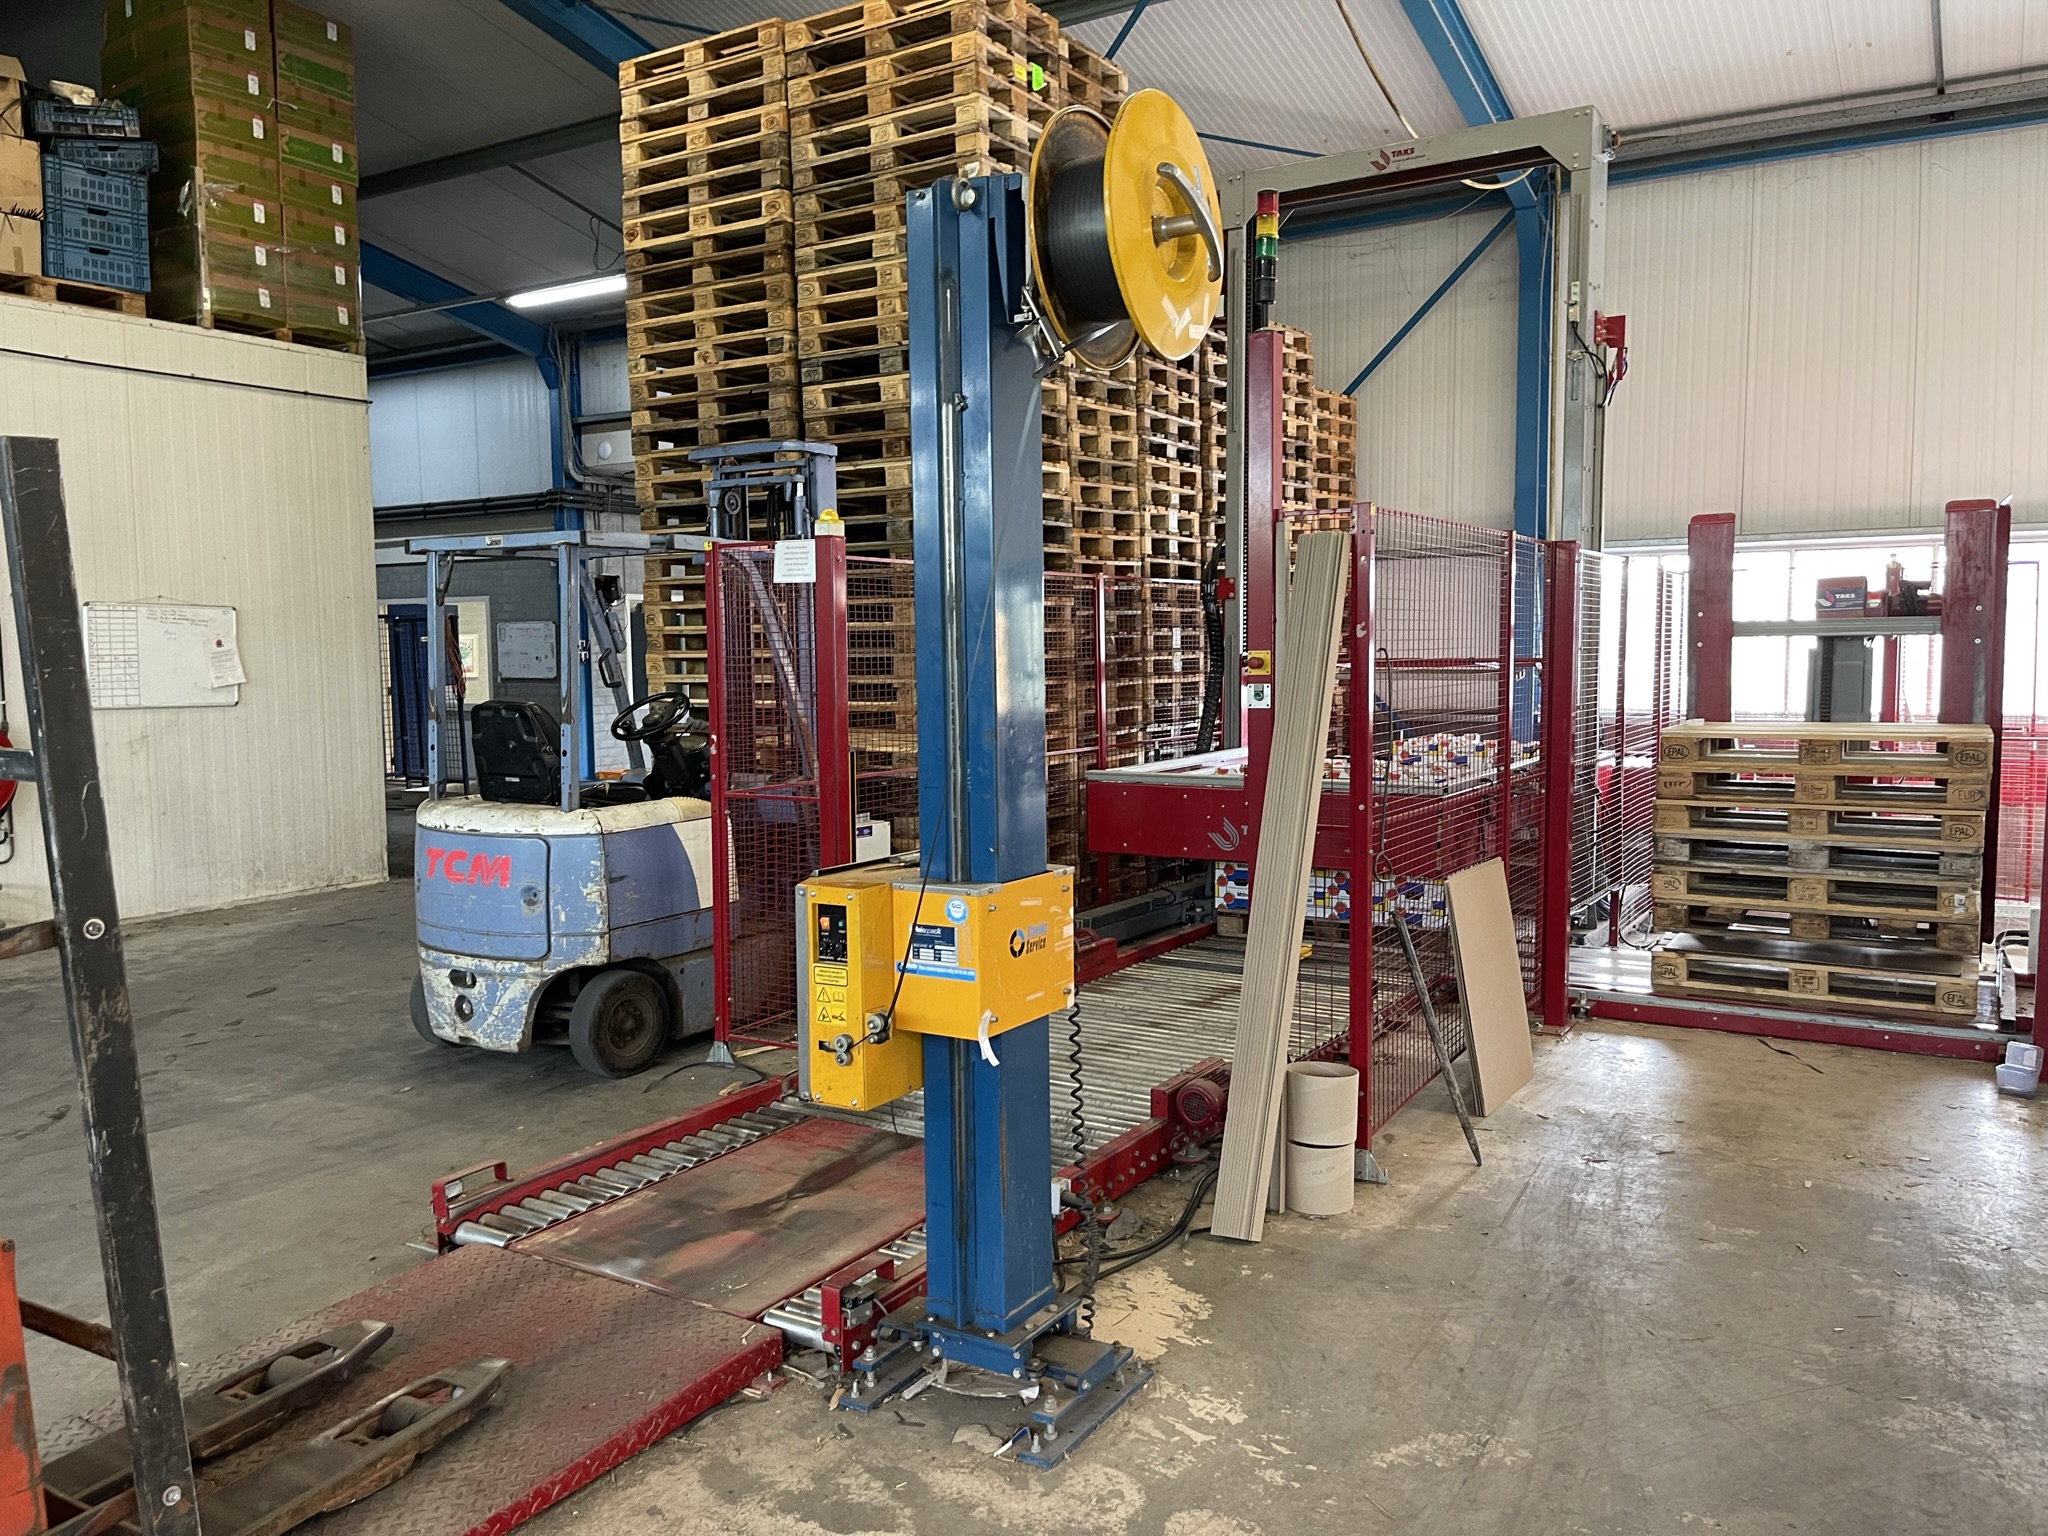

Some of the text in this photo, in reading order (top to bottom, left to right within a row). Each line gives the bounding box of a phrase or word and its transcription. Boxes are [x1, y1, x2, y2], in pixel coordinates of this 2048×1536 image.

[1391, 147, 1415, 158] TAKS
[1667, 747, 1686, 756] EPAL
[1960, 753, 1982, 762] EPAL
[1958, 789, 1976, 800] EUR
[1950, 827, 1970, 836] EPAL
[425, 846, 511, 889] TCM
[1026, 937, 1047, 955] Service
